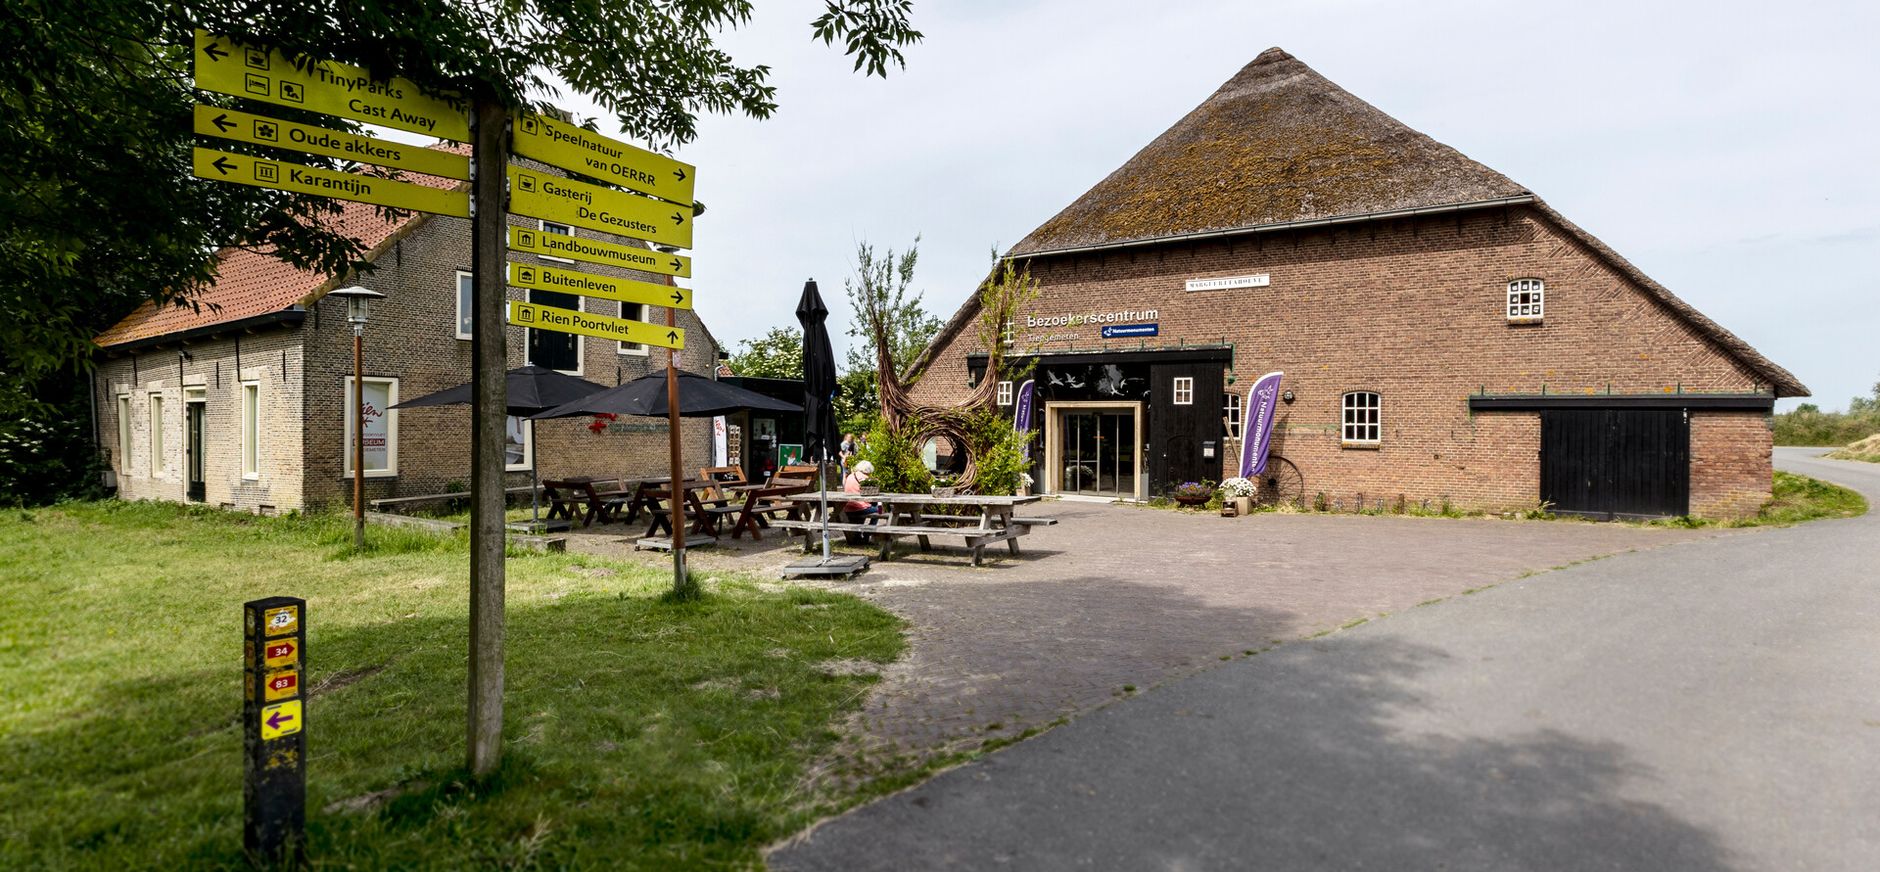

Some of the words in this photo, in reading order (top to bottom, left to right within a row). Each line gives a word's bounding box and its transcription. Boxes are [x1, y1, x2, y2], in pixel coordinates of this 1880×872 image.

[316, 67, 403, 100] TinyParks
[348, 99, 387, 119] Cast
[390, 107, 437, 131] Away
[289, 128, 341, 150] Oude
[345, 139, 401, 161] akkers
[545, 125, 624, 159] Speelnatuur
[289, 169, 372, 196] Karantijn
[585, 157, 608, 171] van
[610, 163, 656, 187] OERRR
[543, 182, 593, 204] Gasterij
[579, 207, 597, 221] De
[599, 212, 657, 234] Gezusters
[542, 236, 656, 266] Landbouwmuseum
[542, 271, 617, 293] Buitenleven
[541, 310, 570, 326] Rien
[573, 315, 629, 336] Poortvliet
[1027, 309, 1159, 328] Bezoekerscentrum
[362, 402, 383, 417] ien
[275, 615, 288, 625] 32
[275, 647, 288, 657] 34
[275, 679, 288, 689] 83
